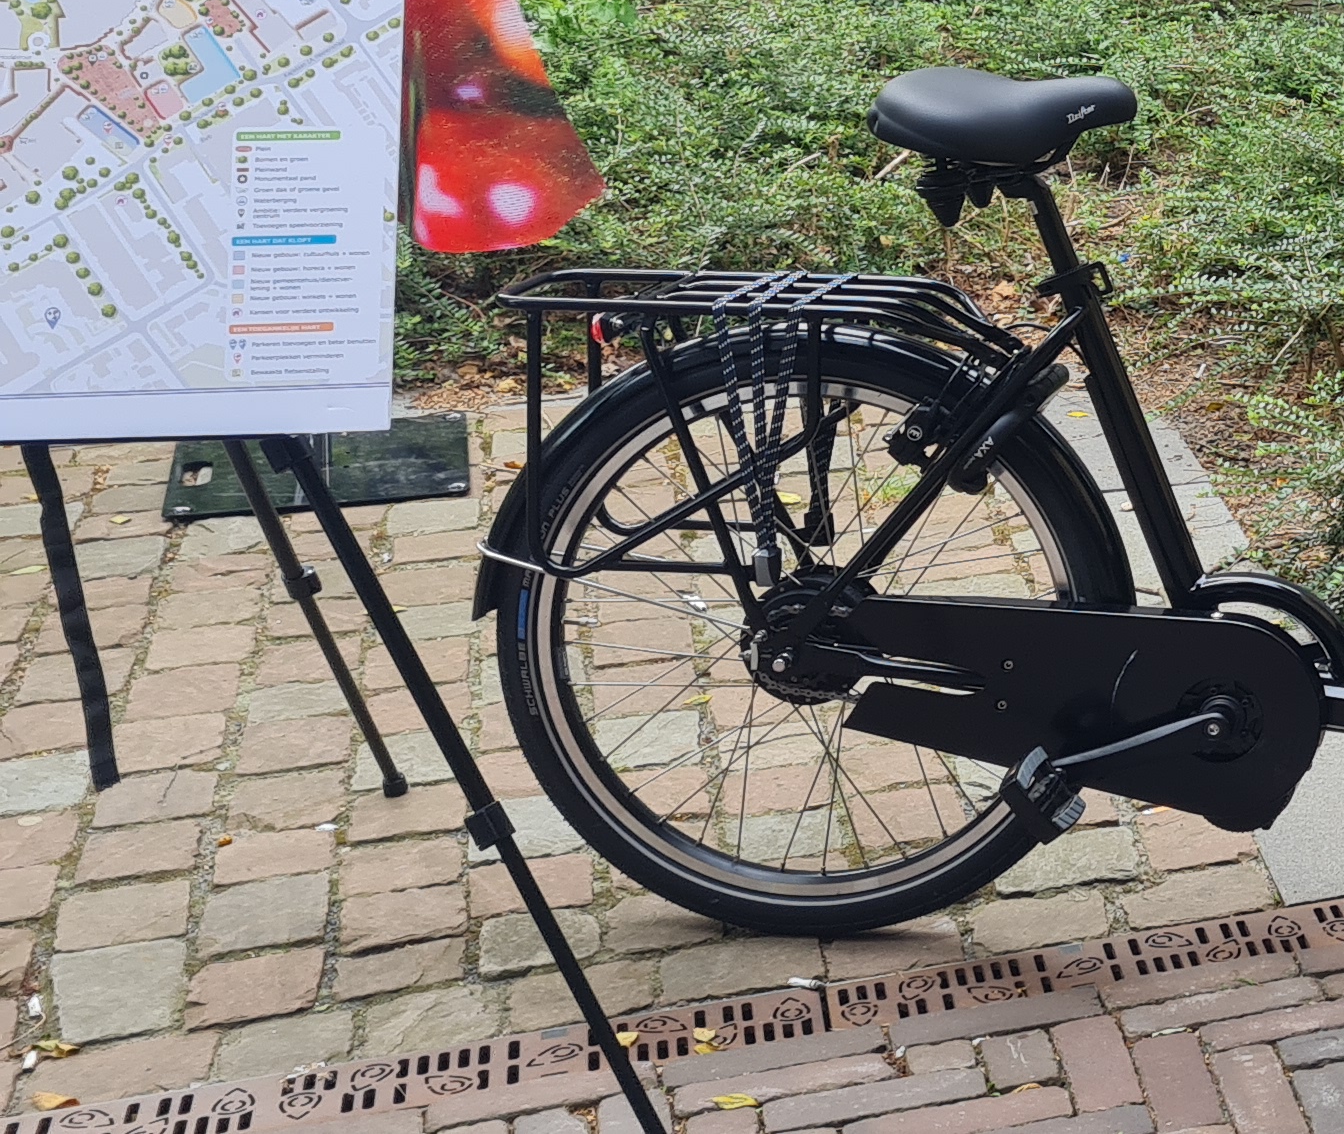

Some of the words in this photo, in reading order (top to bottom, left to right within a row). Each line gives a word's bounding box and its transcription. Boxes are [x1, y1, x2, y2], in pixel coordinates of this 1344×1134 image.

[974, 436, 994, 458] AXA
[518, 642, 538, 716] SCHWALBE
[549, 486, 570, 518] PLUS
